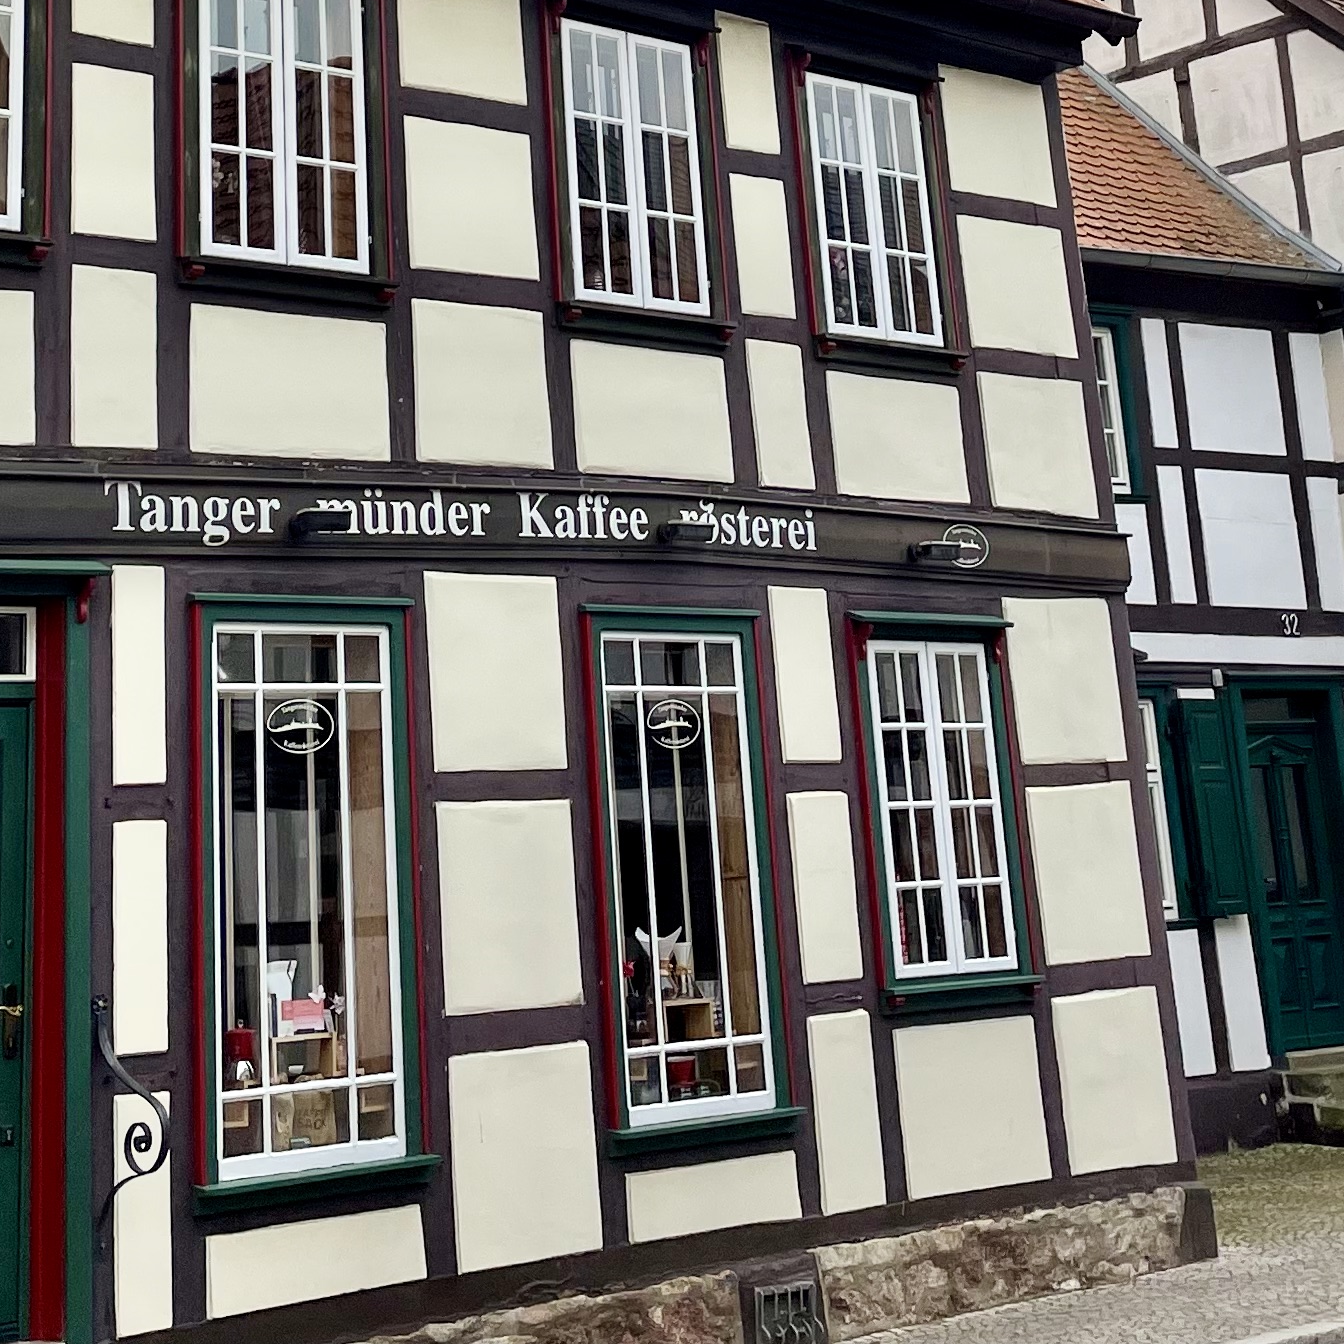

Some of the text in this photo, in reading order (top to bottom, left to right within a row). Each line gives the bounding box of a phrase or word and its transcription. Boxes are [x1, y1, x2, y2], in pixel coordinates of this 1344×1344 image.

[103, 480, 282, 547] Tanger
[315, 487, 492, 537] münder
[515, 491, 650, 541] Kaffee
[1280, 613, 1301, 636] 32
